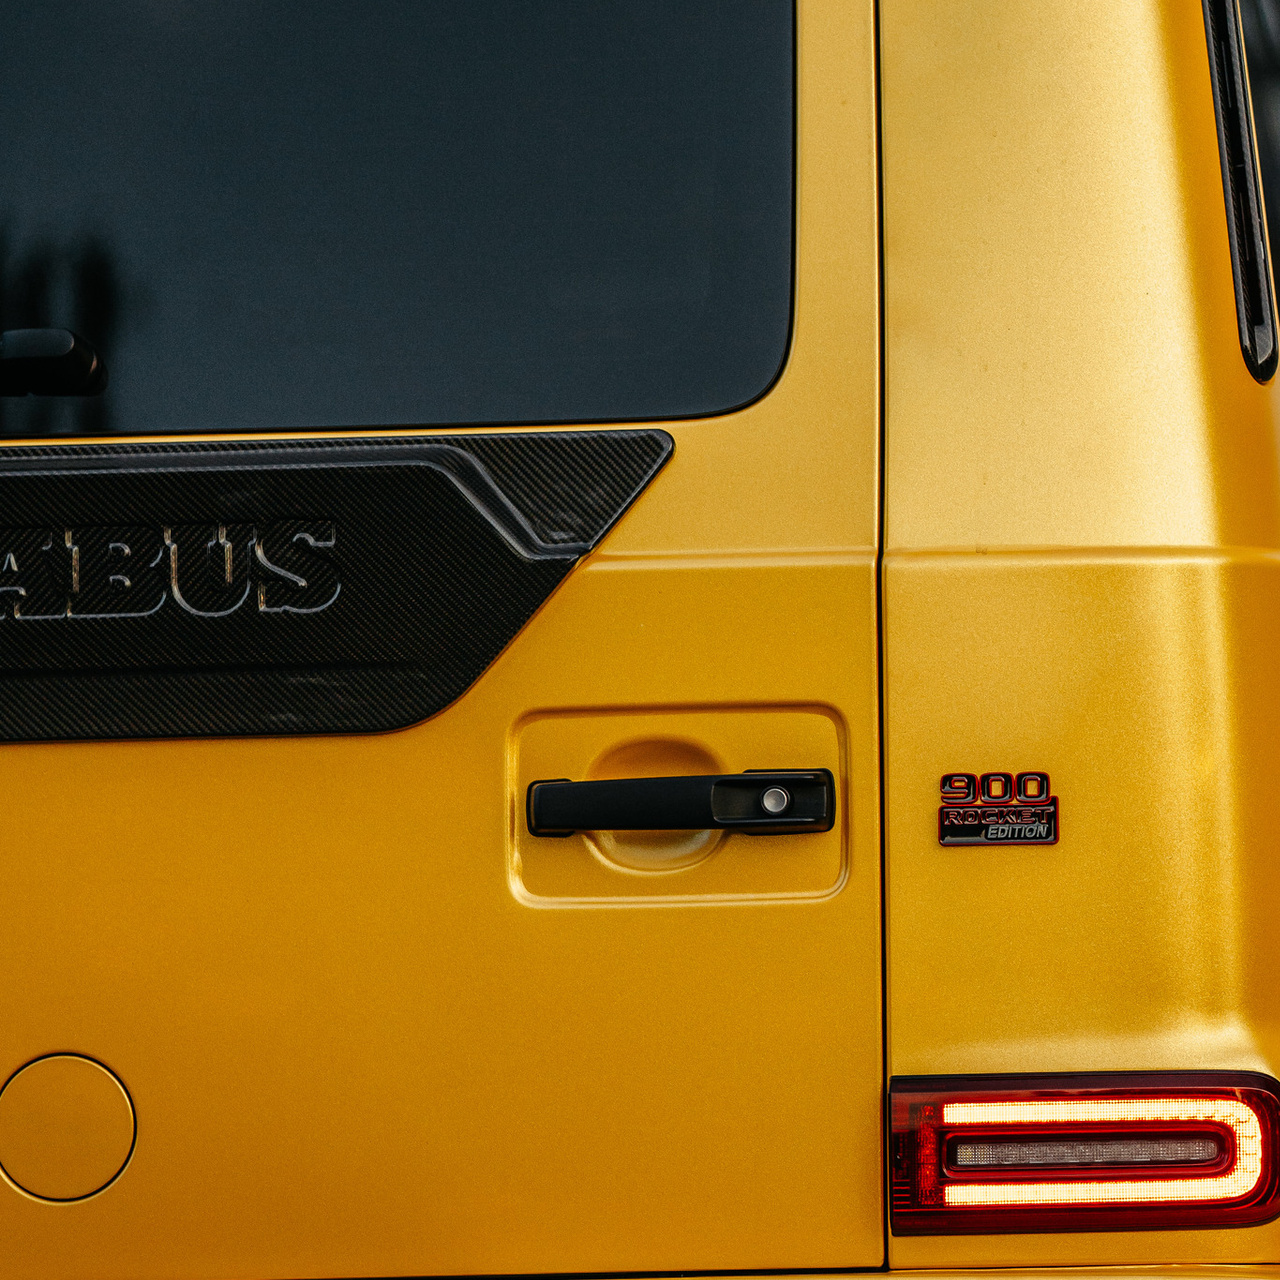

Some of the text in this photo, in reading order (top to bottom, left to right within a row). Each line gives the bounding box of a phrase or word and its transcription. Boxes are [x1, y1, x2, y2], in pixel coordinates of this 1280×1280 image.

[940, 771, 1050, 805] 900
[943, 807, 1055, 826] ROCKET
[987, 824, 1049, 839] EDITION
